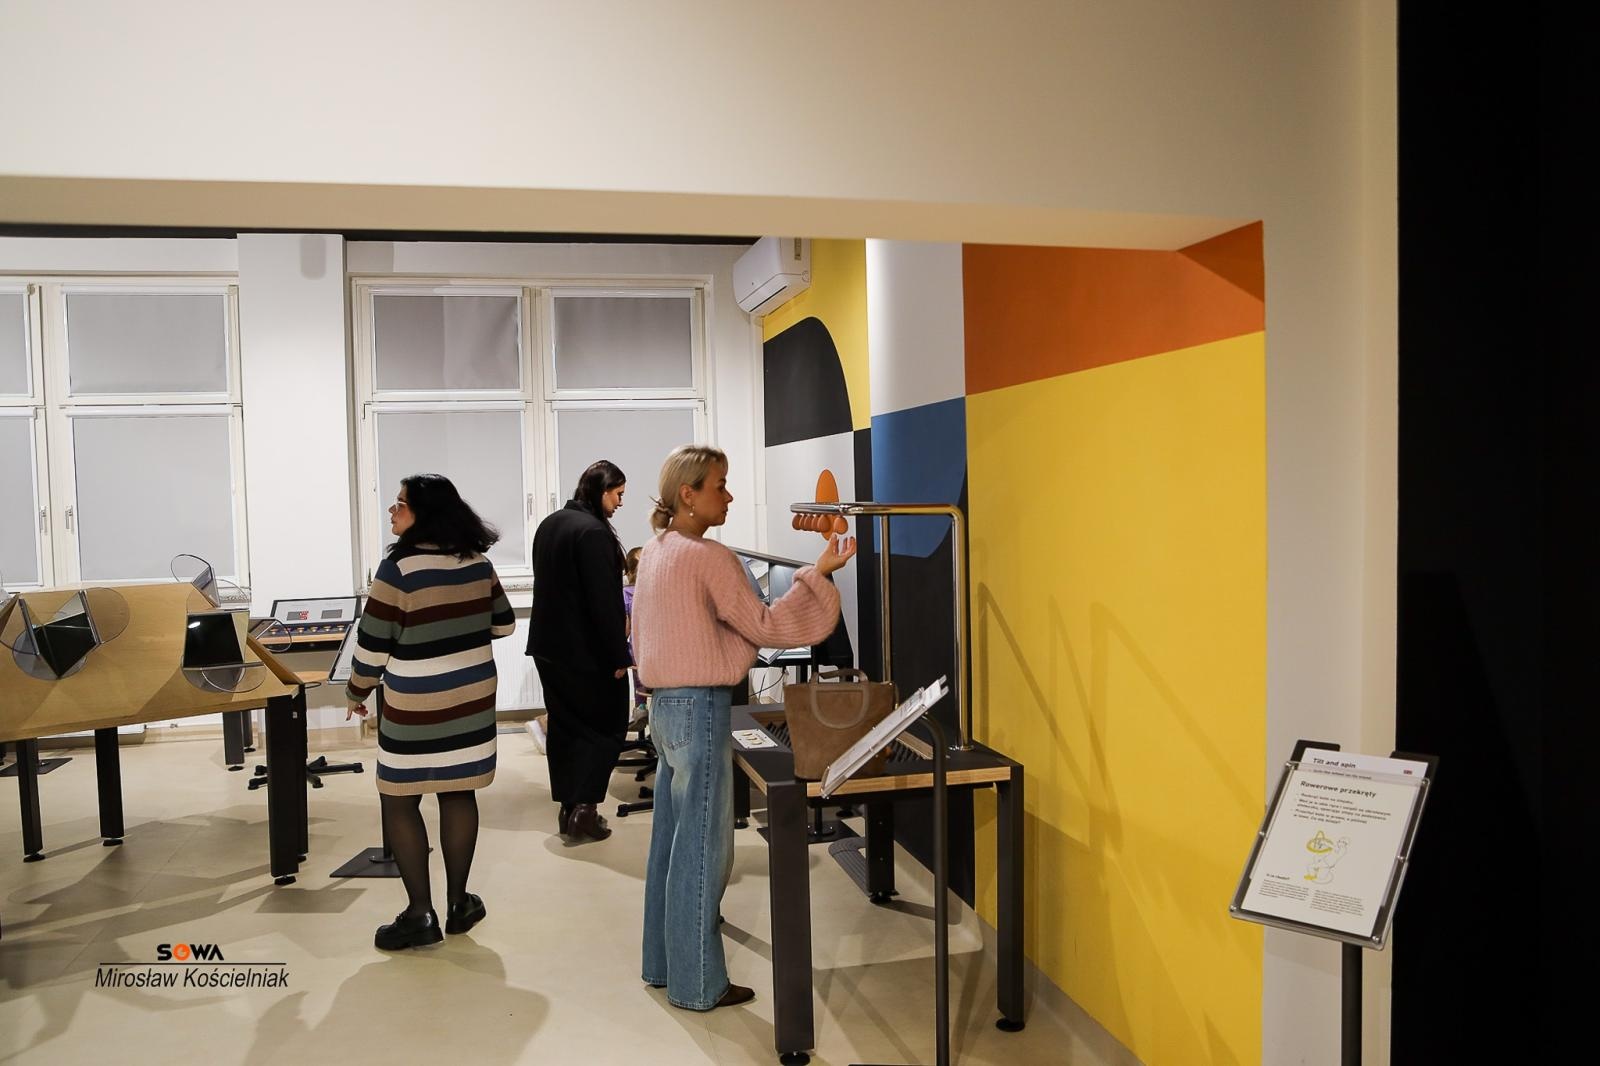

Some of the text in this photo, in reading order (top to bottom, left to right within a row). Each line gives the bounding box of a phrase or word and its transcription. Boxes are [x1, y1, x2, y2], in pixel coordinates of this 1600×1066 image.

[1326, 759, 1339, 767] and
[1300, 780, 1338, 792] Rowerowe
[1339, 786, 1377, 798] przekręty
